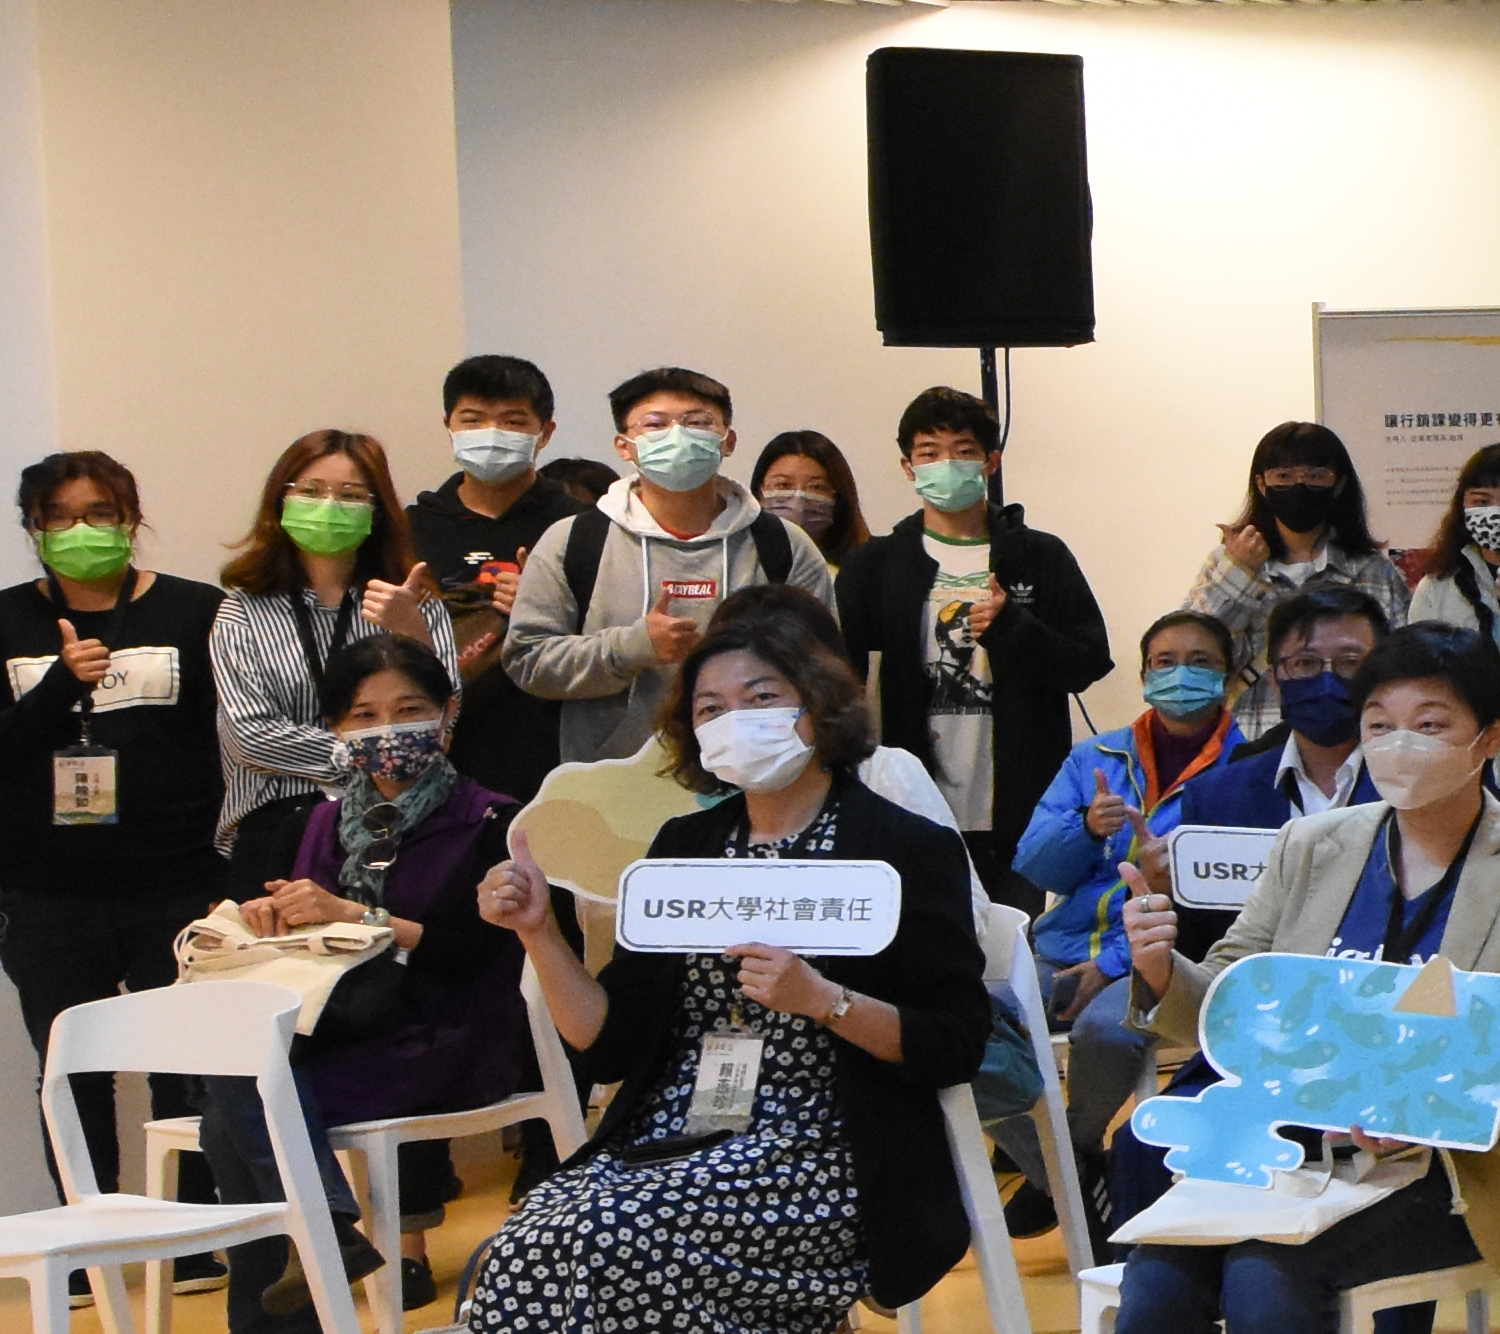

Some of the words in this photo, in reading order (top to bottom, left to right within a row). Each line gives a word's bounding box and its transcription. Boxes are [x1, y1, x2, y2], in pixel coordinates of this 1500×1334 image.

[644, 896, 873, 922] USR大學社會責任
